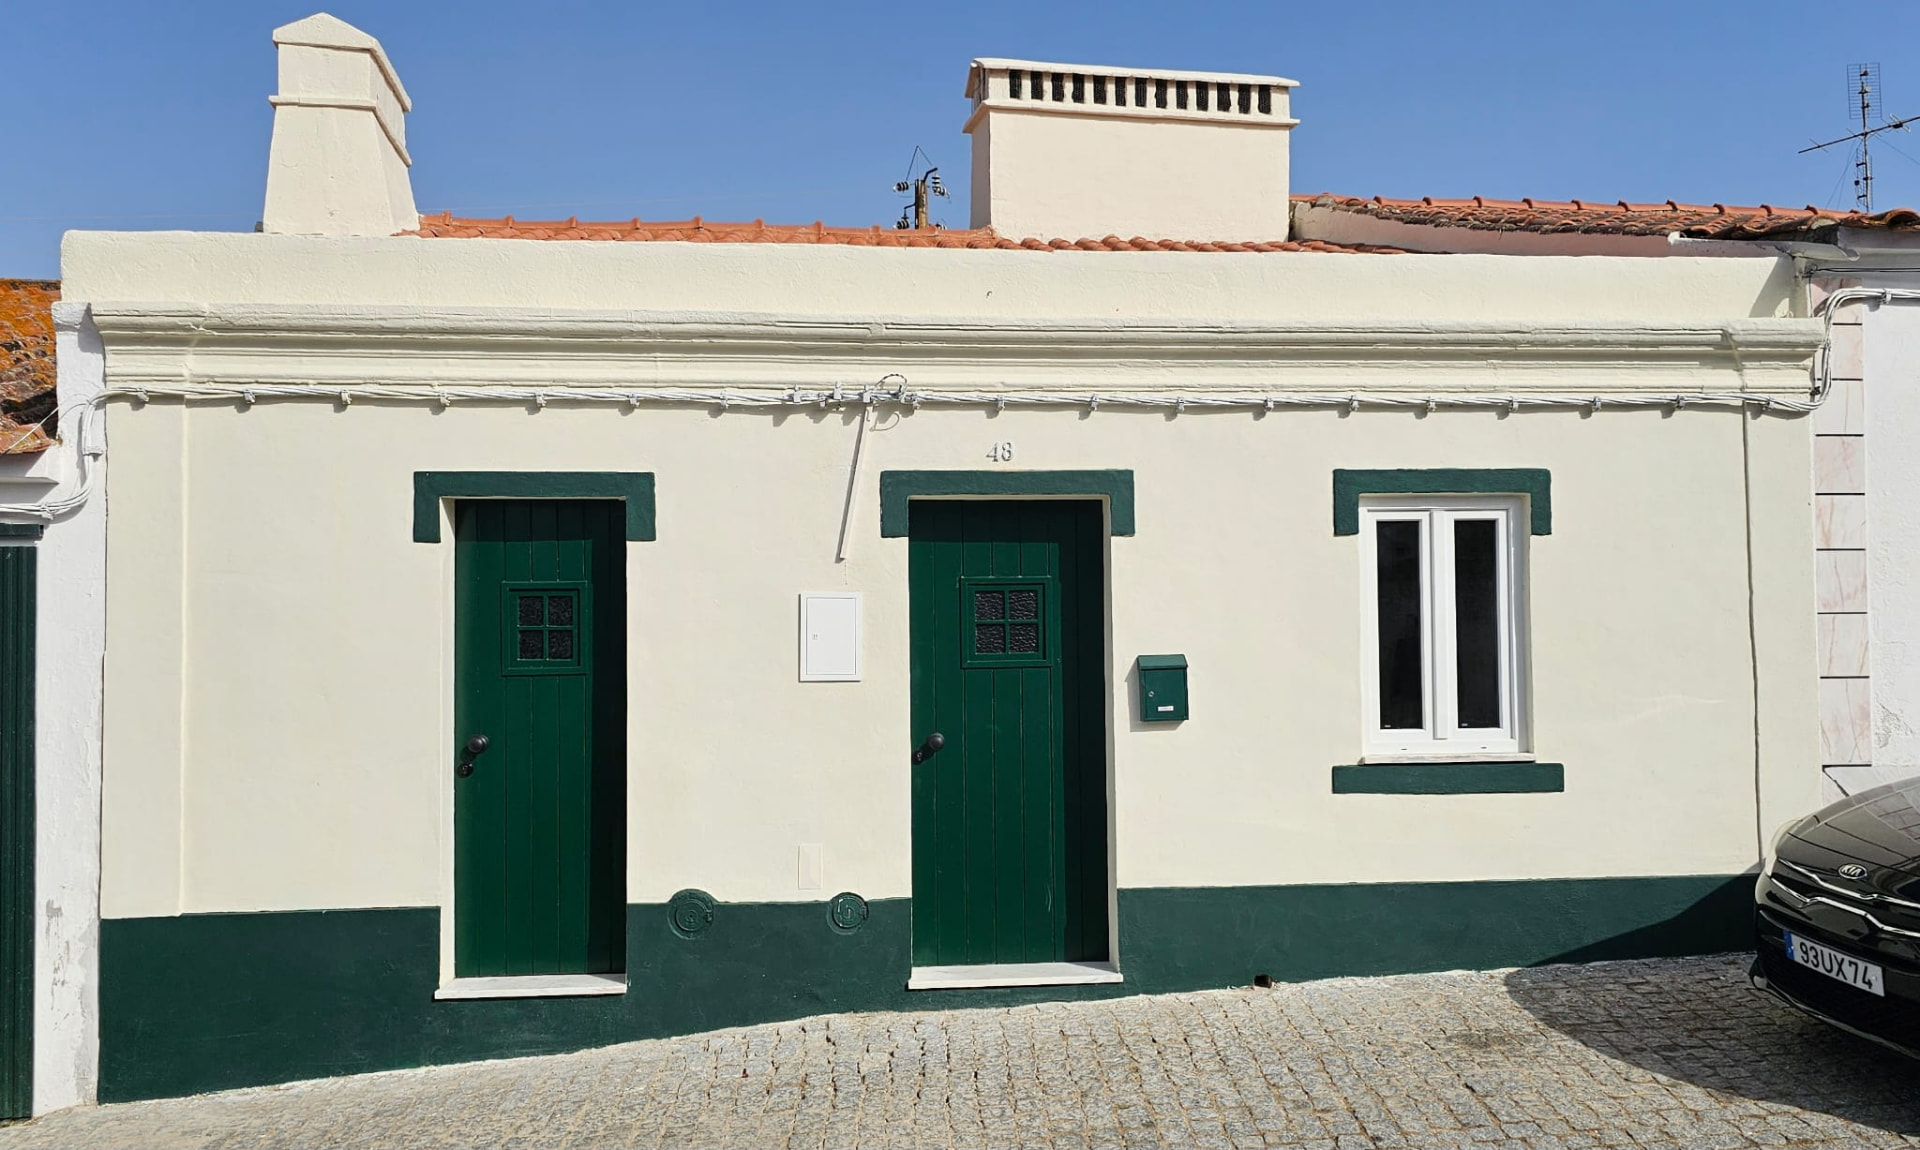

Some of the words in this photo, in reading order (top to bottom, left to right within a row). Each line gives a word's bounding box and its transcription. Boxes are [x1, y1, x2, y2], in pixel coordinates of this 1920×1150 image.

[985, 442, 1012, 462] 48
[1841, 865, 1862, 877] KIA
[1799, 941, 1873, 990] 93UX74
